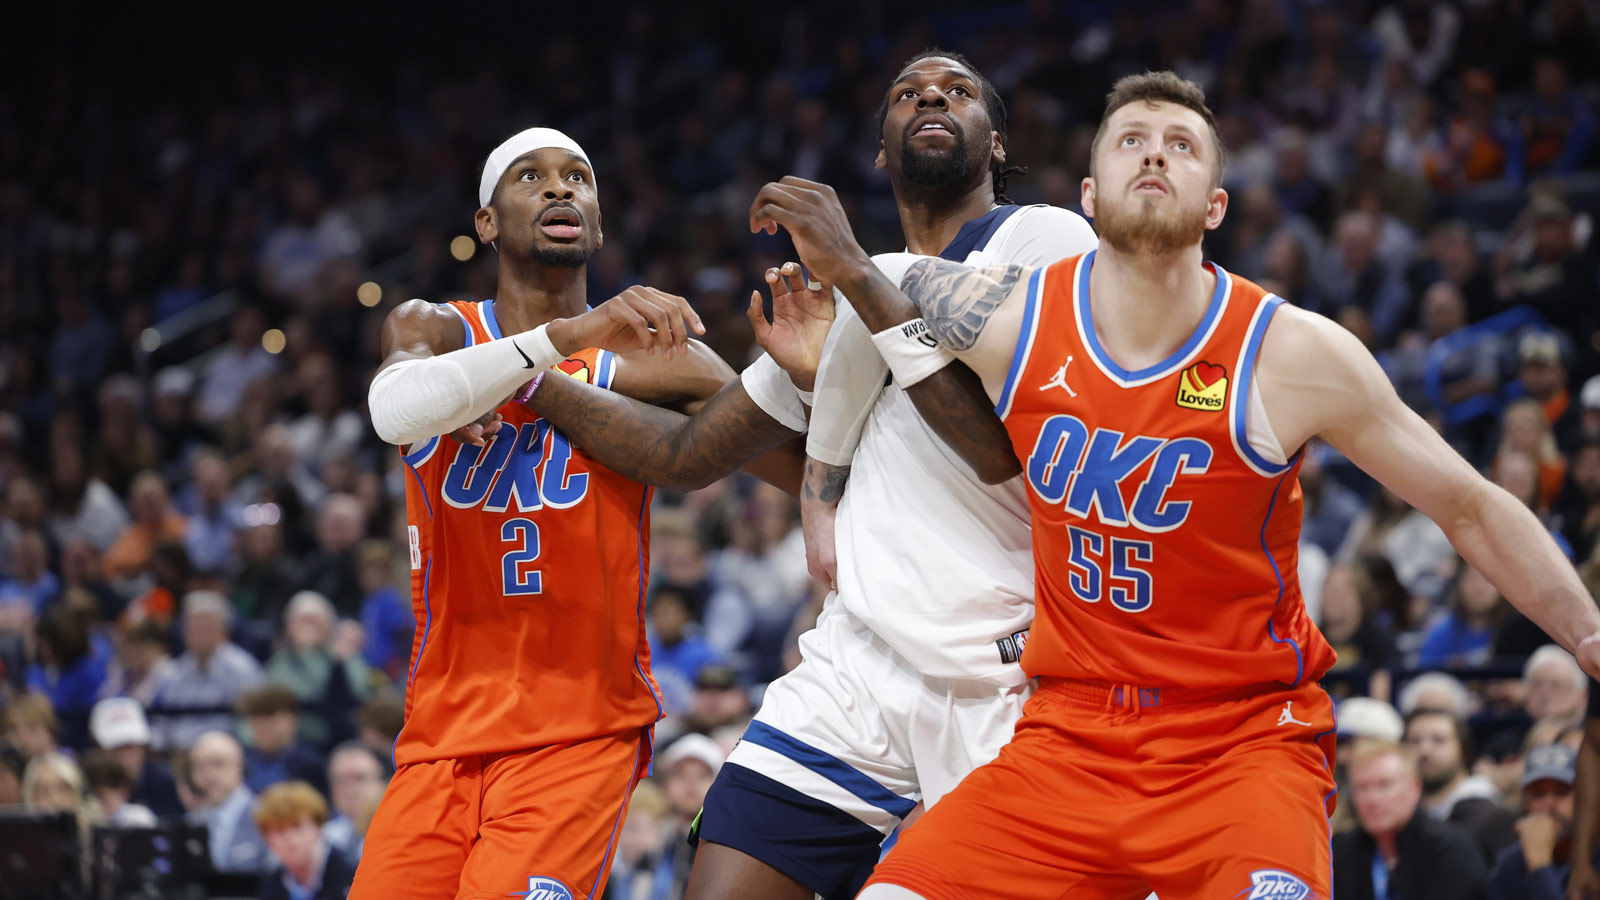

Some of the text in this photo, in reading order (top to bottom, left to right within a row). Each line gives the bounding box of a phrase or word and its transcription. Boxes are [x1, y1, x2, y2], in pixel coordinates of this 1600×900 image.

[441, 418, 589, 513] OKC
[1027, 414, 1213, 533] OKC
[501, 517, 542, 596] 2
[1066, 524, 1153, 613] 55
[1114, 687, 1160, 707] THDER
[1249, 880, 1297, 899] OKC
